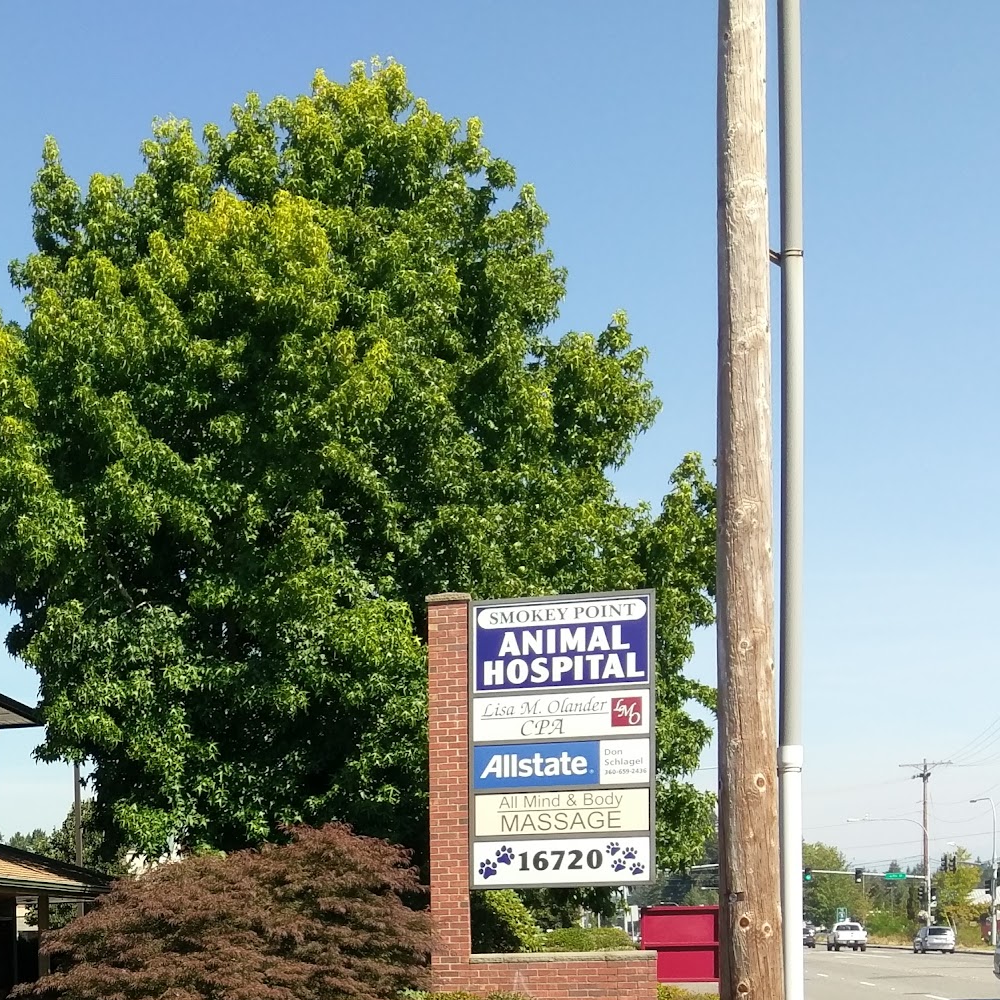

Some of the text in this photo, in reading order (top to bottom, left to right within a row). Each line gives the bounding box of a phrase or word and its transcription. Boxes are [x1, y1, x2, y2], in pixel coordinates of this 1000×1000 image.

[489, 603, 636, 625] SMOKEY POINT
[498, 624, 630, 657] ANIMAL
[483, 652, 645, 686] HOSPITAL
[481, 696, 608, 718] Lisa M. Olander
[520, 718, 566, 737] CPA
[604, 748, 623, 756] Don
[604, 757, 643, 767] Schlagel
[480, 751, 588, 779] Allstate
[499, 792, 623, 809] All Mind & Body
[501, 811, 622, 832] MASSAGE
[518, 849, 603, 871] 16720
